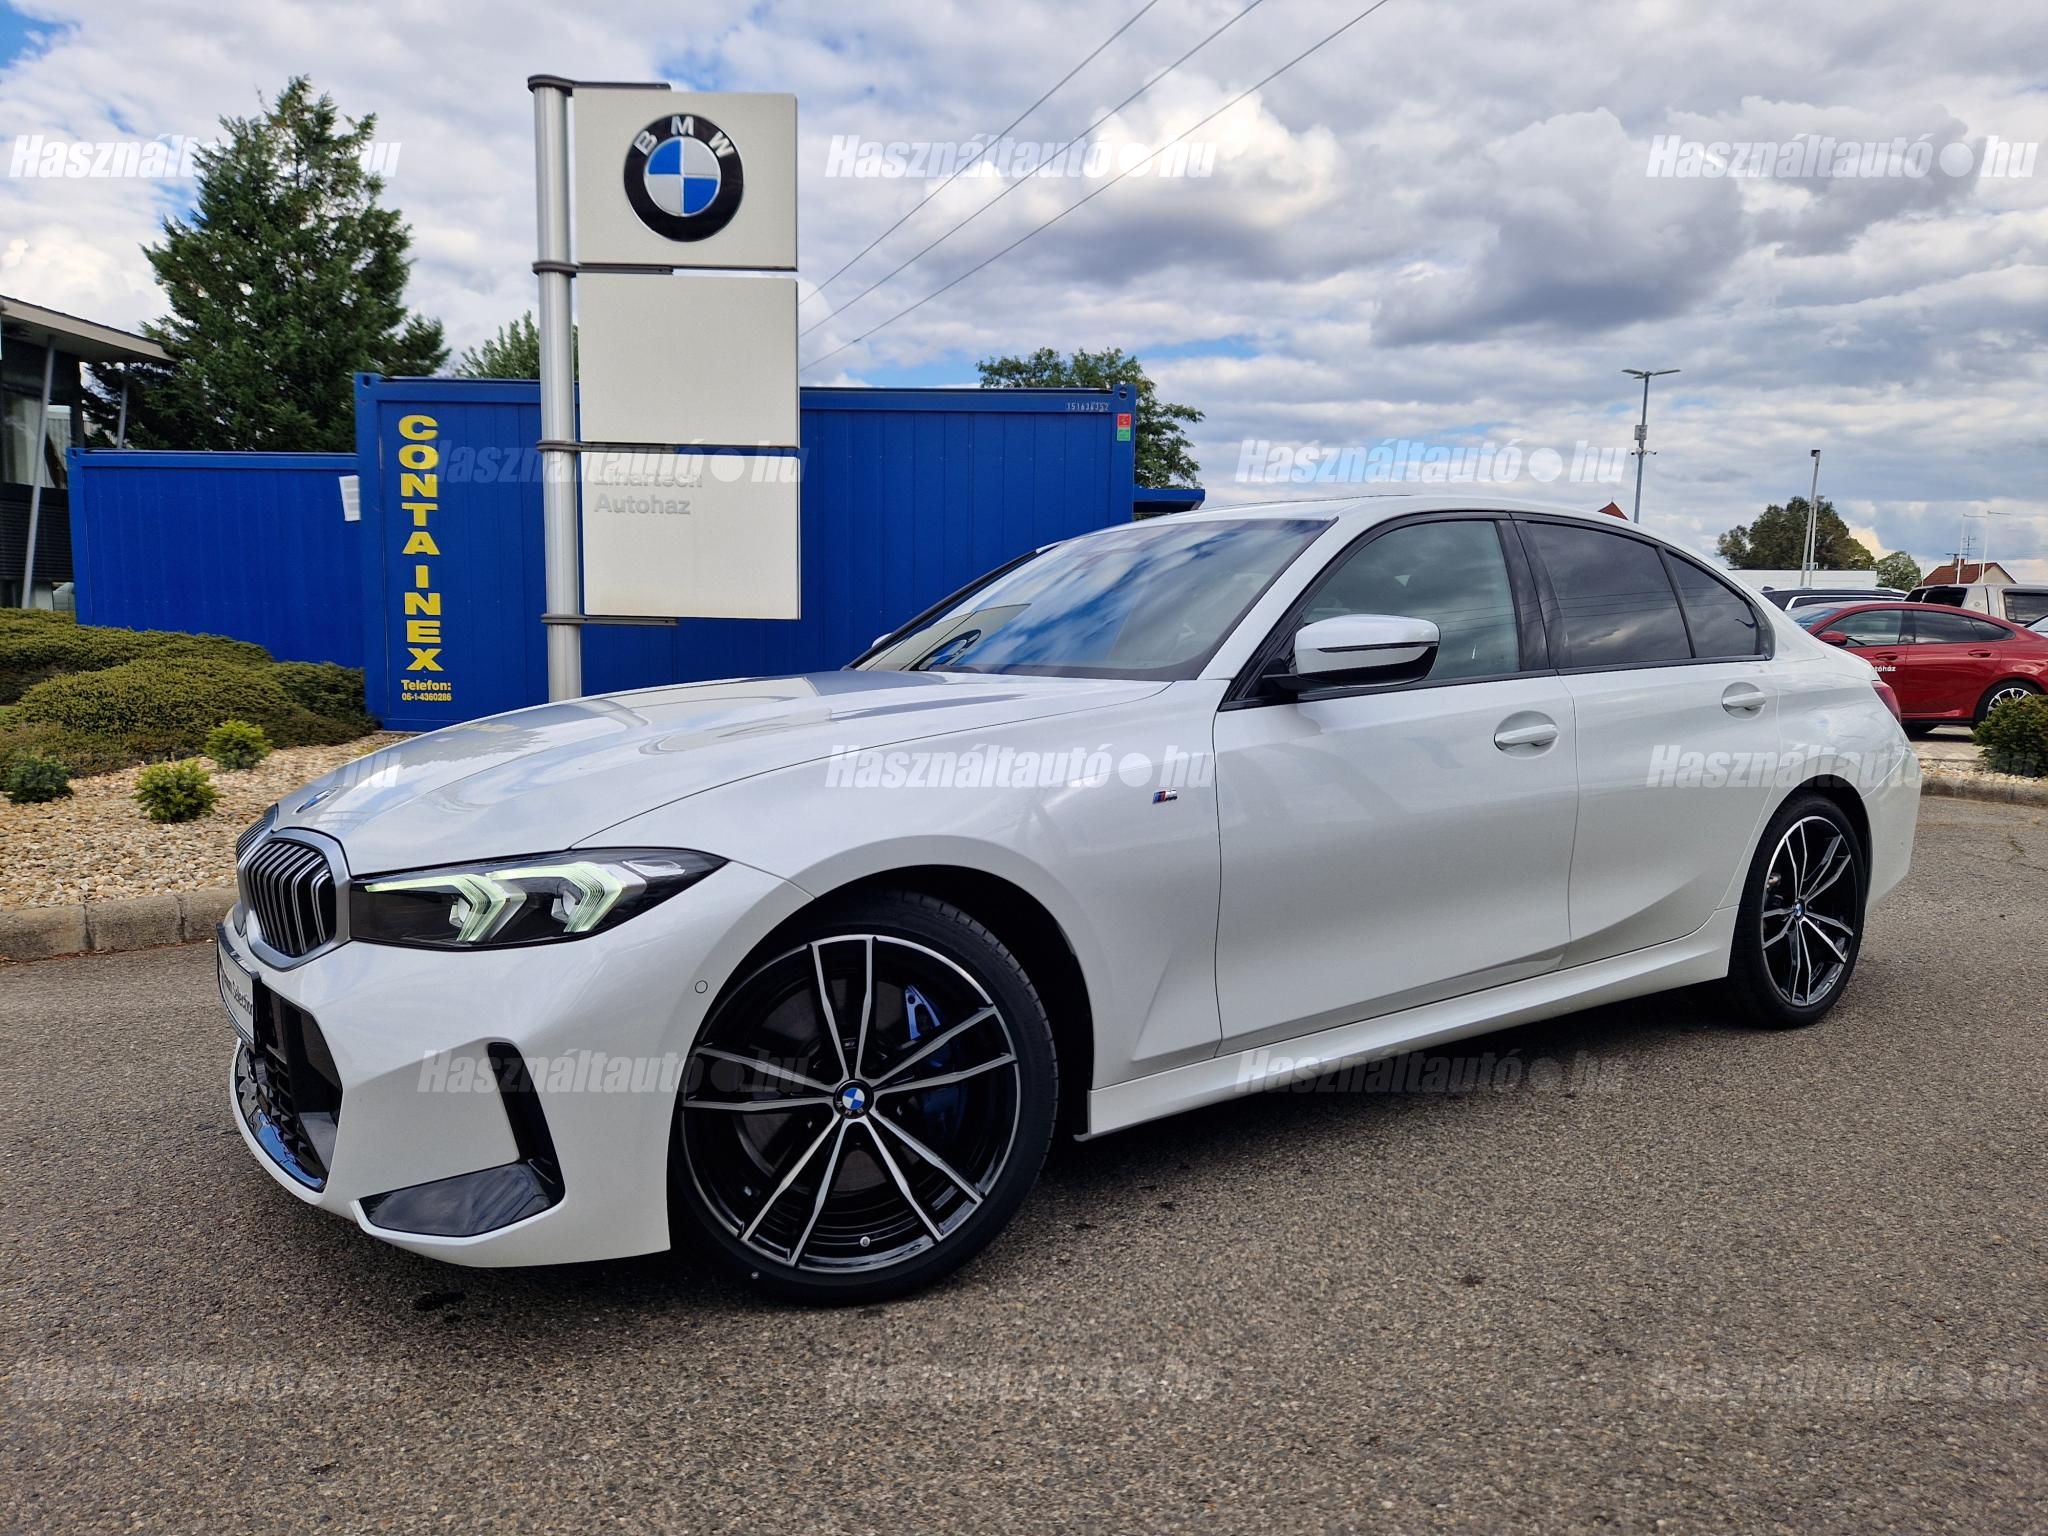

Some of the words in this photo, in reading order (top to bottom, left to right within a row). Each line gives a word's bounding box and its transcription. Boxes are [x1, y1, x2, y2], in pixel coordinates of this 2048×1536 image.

[632, 115, 736, 158] BMW
[398, 414, 444, 671] CONTAINEX
[401, 679, 452, 691] Telefon:
